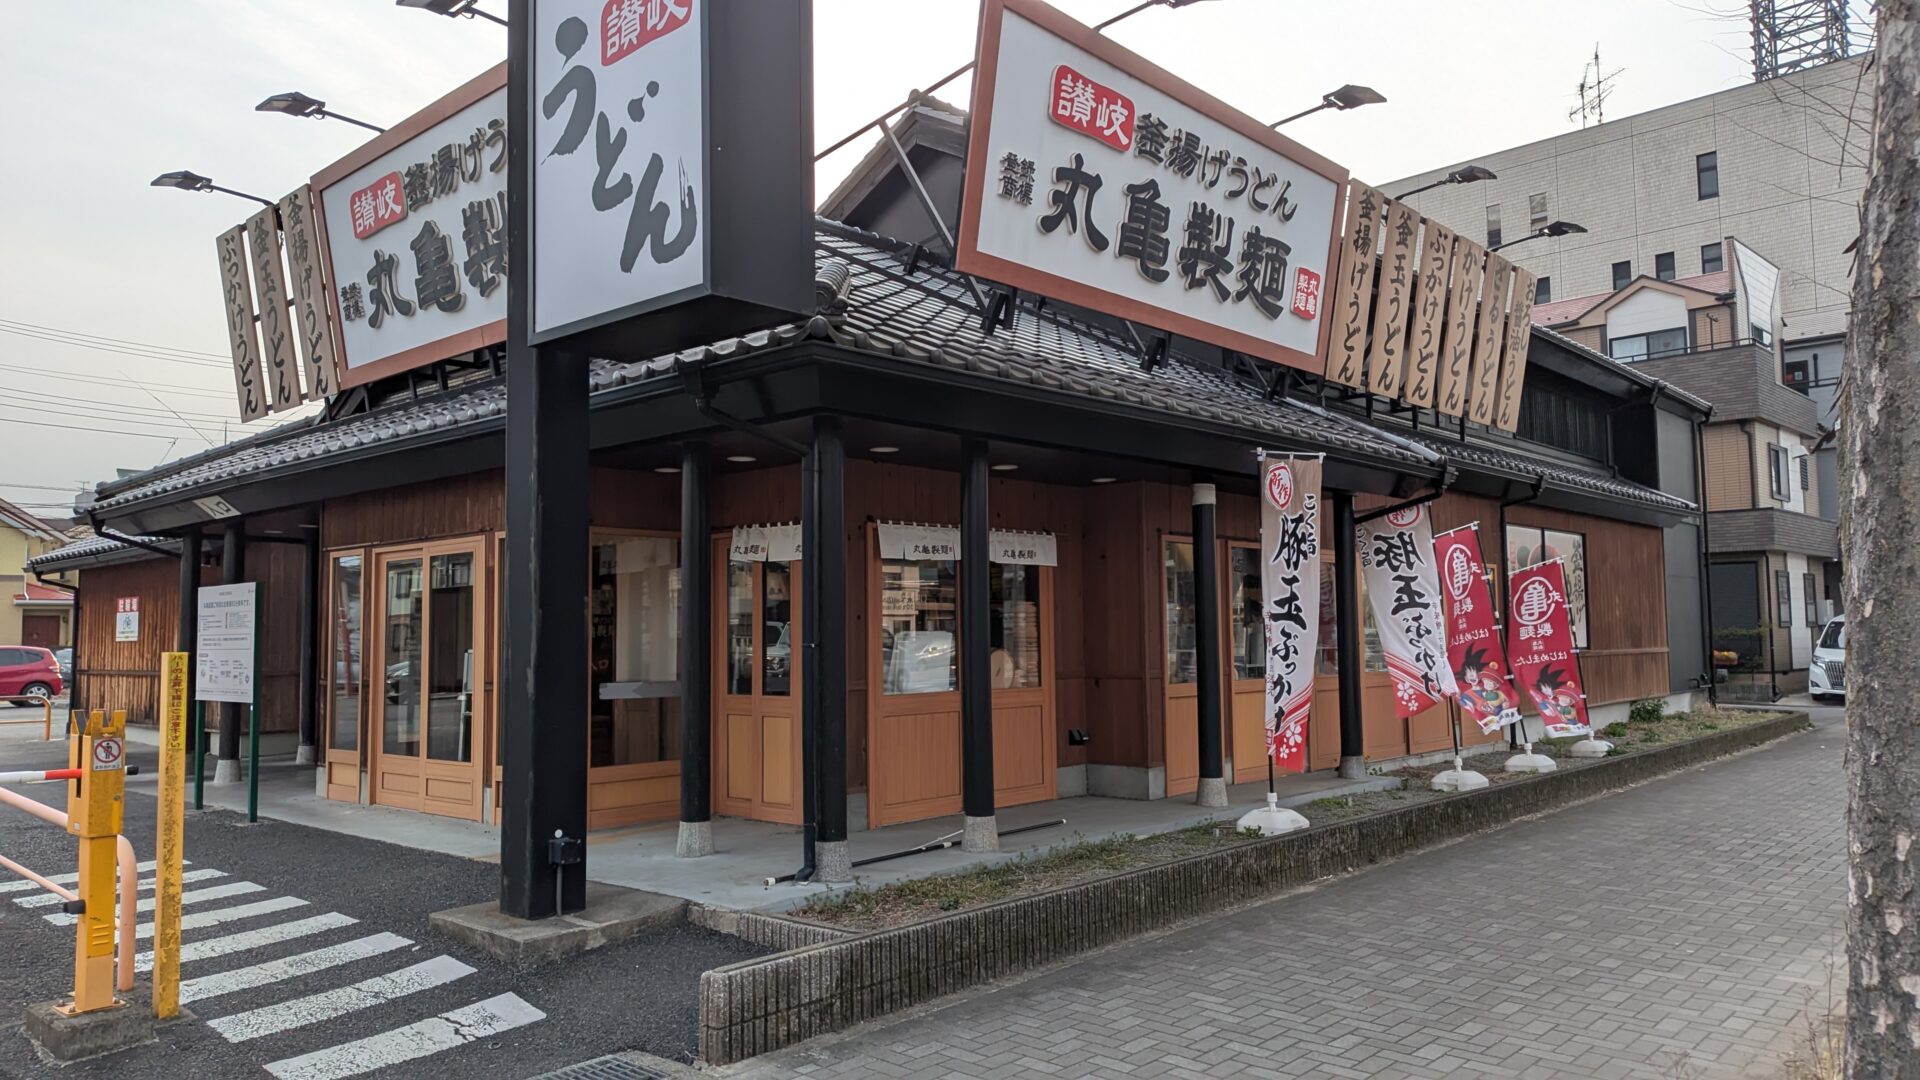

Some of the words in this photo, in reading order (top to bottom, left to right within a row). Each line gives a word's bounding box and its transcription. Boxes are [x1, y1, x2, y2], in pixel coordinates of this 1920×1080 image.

[607, 0, 688, 58] 讃岐
[1058, 73, 1129, 145] 讃岐
[354, 180, 402, 234] 讃岐
[404, 118, 508, 212] 釜揚げう
[541, 16, 697, 273] うどん
[1133, 113, 1298, 223] 釜揚げうどん
[253, 217, 291, 404] 釜玉うどん
[287, 193, 329, 397] 釜揚げうどん
[367, 190, 508, 329] 丸亀製
[1036, 153, 1292, 320] 丸亀製麺
[1338, 188, 1376, 383] 釜揚げうどん
[1377, 211, 1413, 391] 釜玉うどん
[1412, 229, 1448, 400] ぶっかけうどん
[222, 235, 258, 416] ぶっかけうどん
[1445, 244, 1477, 410] かけうどん
[1475, 261, 1507, 419] ざるうどん
[201, 500, 232, 517] 入口
